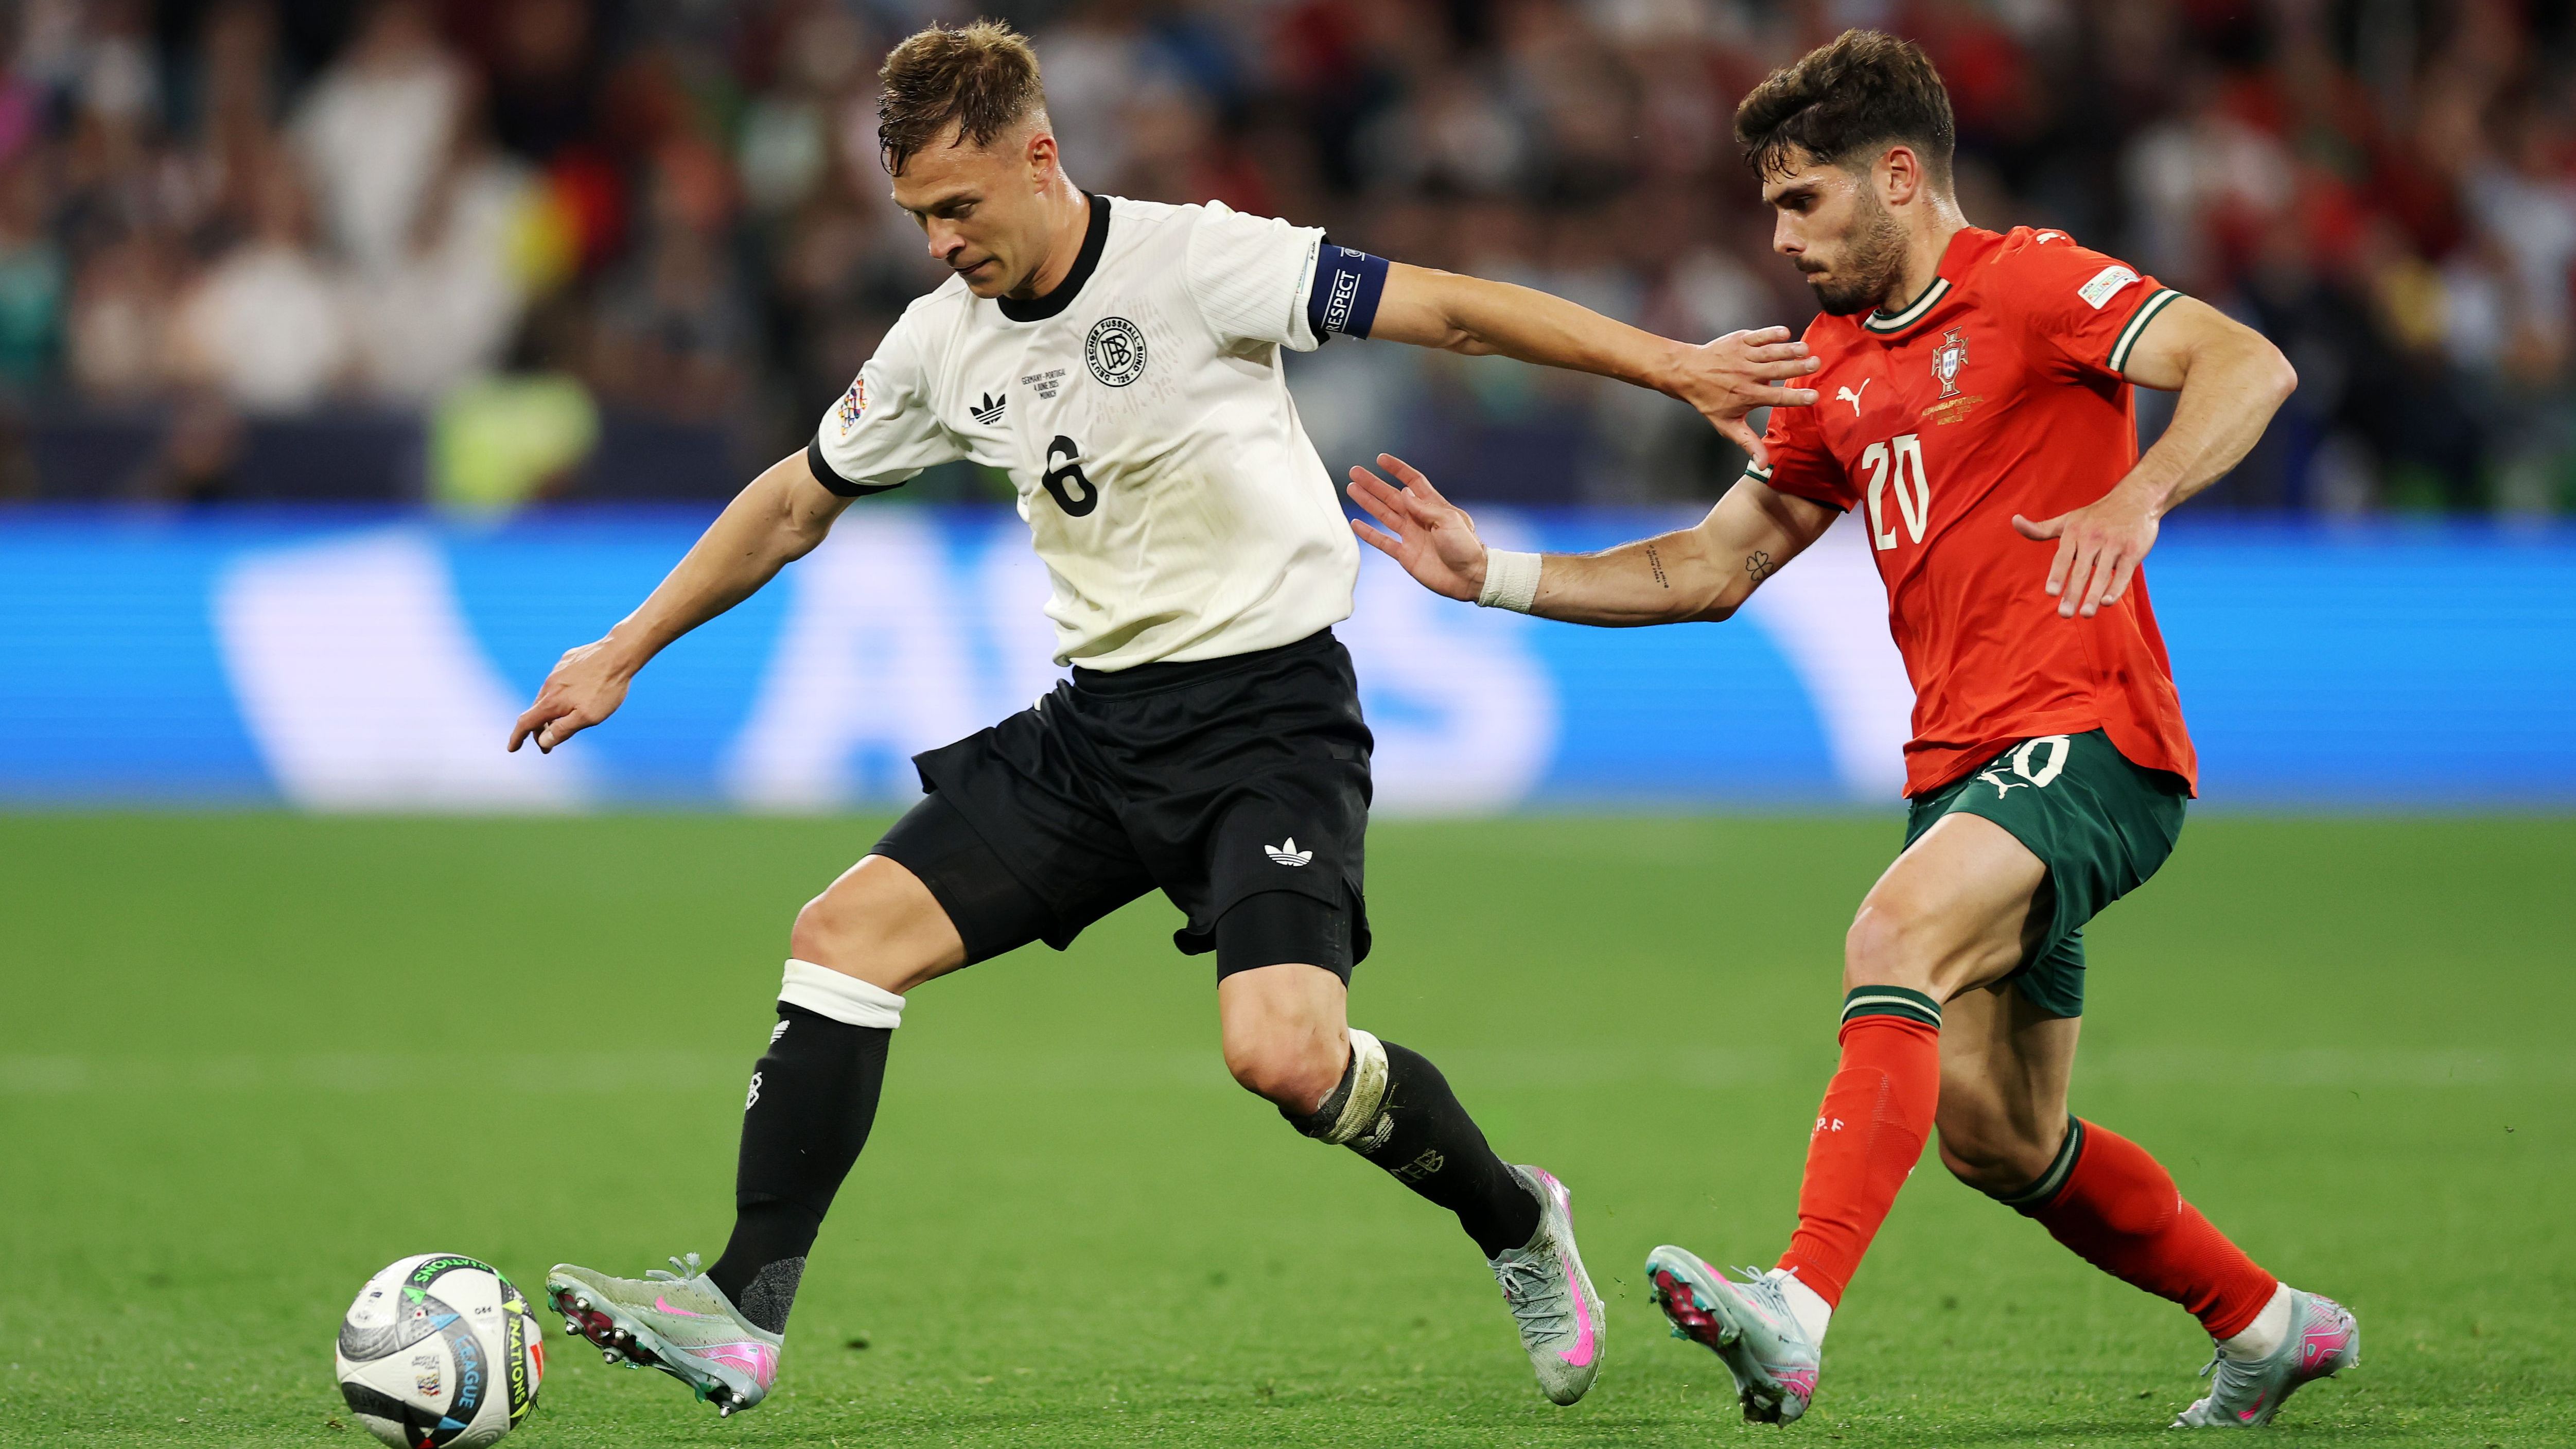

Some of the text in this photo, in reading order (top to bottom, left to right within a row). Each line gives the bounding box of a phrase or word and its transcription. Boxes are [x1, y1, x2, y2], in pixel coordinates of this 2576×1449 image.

[1325, 270, 1355, 332] RESPECT
[1088, 329, 1110, 381] DEUTSCHER
[1117, 374, 1130, 383] 125
[1042, 435, 1098, 517] 6
[1861, 433, 1930, 550] 20
[455, 1334, 480, 1408] LEAGUE
